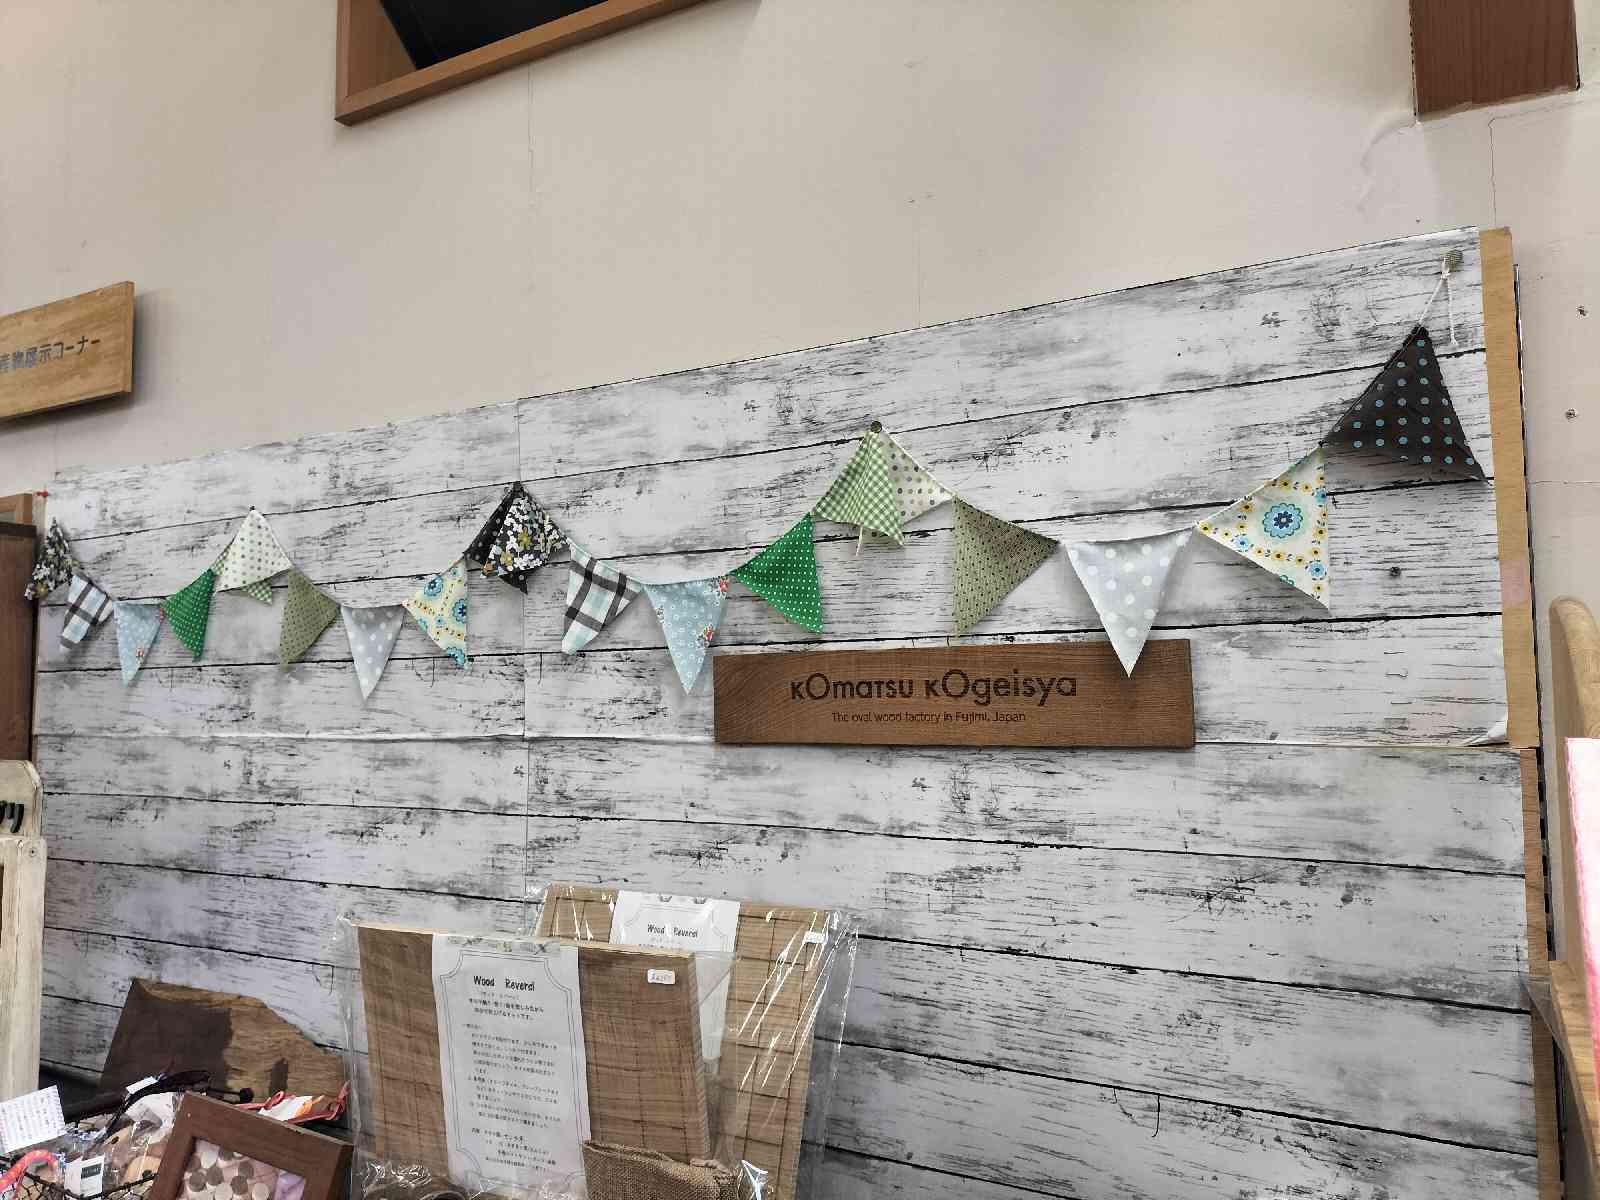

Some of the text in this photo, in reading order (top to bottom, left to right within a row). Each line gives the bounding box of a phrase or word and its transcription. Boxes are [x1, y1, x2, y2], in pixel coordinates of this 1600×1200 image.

[832, 712, 848, 722] The
[851, 712, 872, 722] oval
[873, 712, 901, 722] wood
[905, 711, 943, 724] factory
[943, 711, 953, 721] in
[993, 711, 1026, 724] Japan
[647, 923, 666, 934] Wood
[473, 975, 495, 987] Wood
